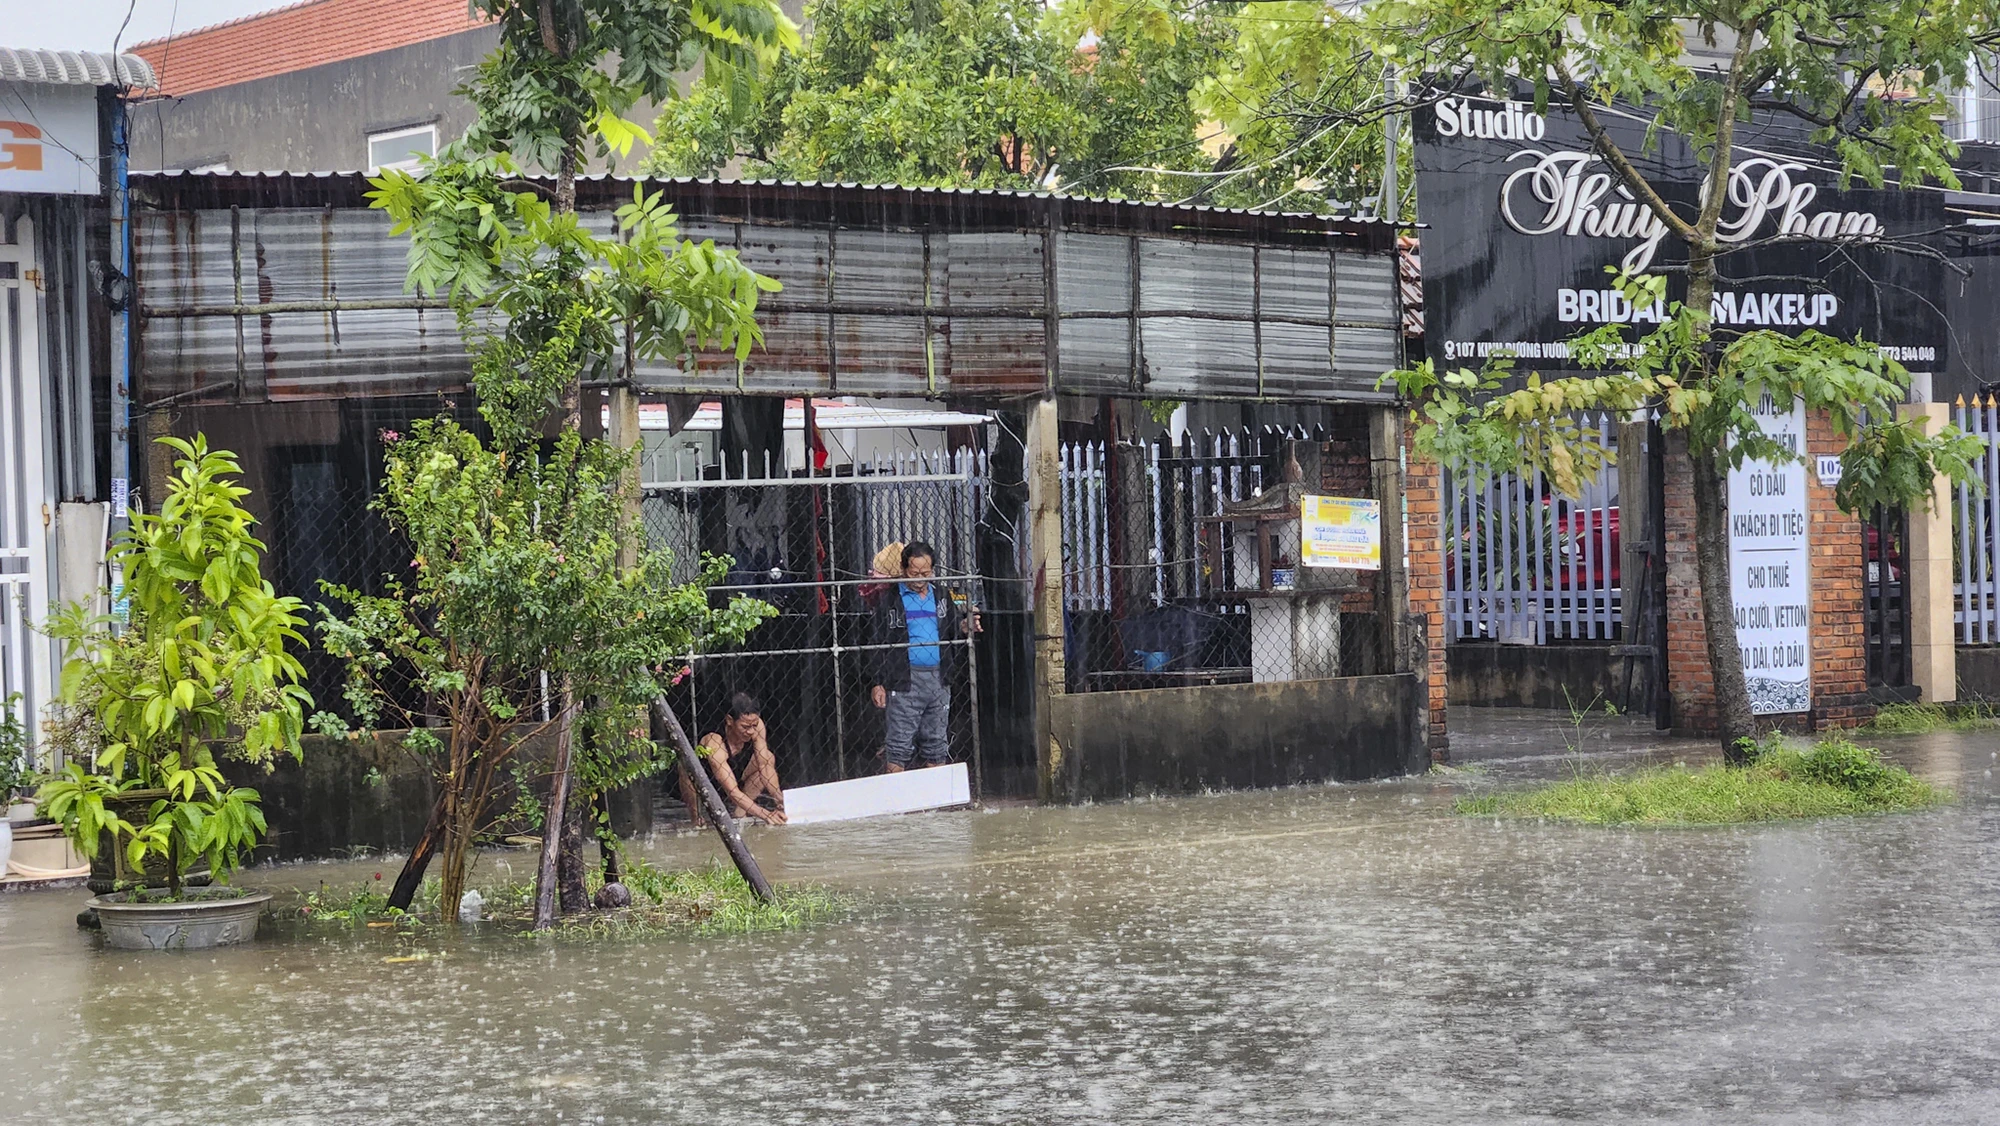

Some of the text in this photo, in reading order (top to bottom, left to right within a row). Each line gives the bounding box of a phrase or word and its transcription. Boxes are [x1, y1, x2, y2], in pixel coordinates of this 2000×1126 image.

[1435, 97, 1545, 141] Studio
[1558, 288, 1838, 326] BRIDAL MAKEUP
[1456, 341, 1475, 358] 107
[1542, 340, 1577, 359] VƯƠN
[1902, 346, 1917, 362] 544
[1918, 346, 1935, 361] 048
[1750, 469, 1763, 496] CÔ
[1821, 460, 1841, 475] 107
[1733, 508, 1804, 541] KHÁCH ĐI TIỆC
[1747, 560, 1790, 589] CHO THUÊ
[1735, 601, 1807, 632] ÁO CƯỚI, VETTON
[1753, 641, 1770, 672] DÀI,
[1772, 641, 1784, 668] CÔ
[1787, 640, 1804, 667] DÂU
